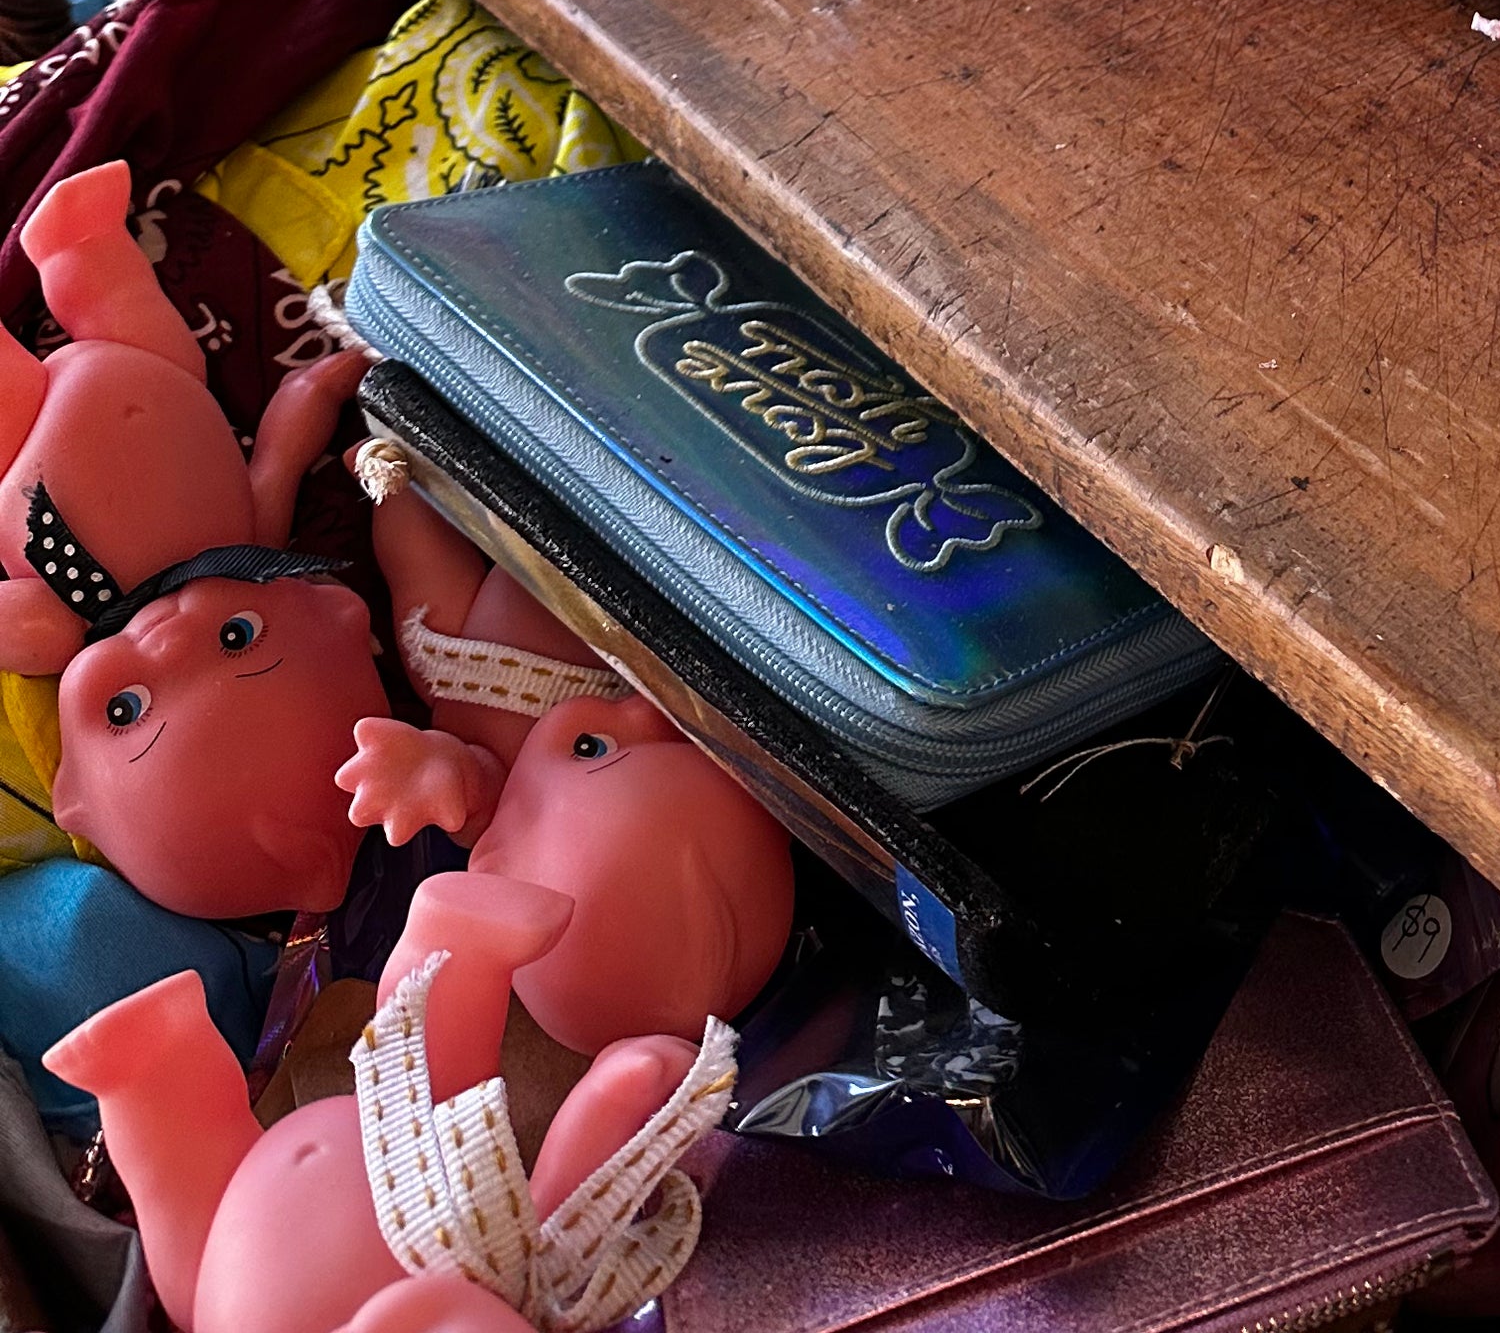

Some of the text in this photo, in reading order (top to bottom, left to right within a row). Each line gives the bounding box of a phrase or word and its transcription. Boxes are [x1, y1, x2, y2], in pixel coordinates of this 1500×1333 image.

[674, 339, 899, 476] love
[740, 319, 960, 443] you
[1391, 893, 1441, 964] $9
